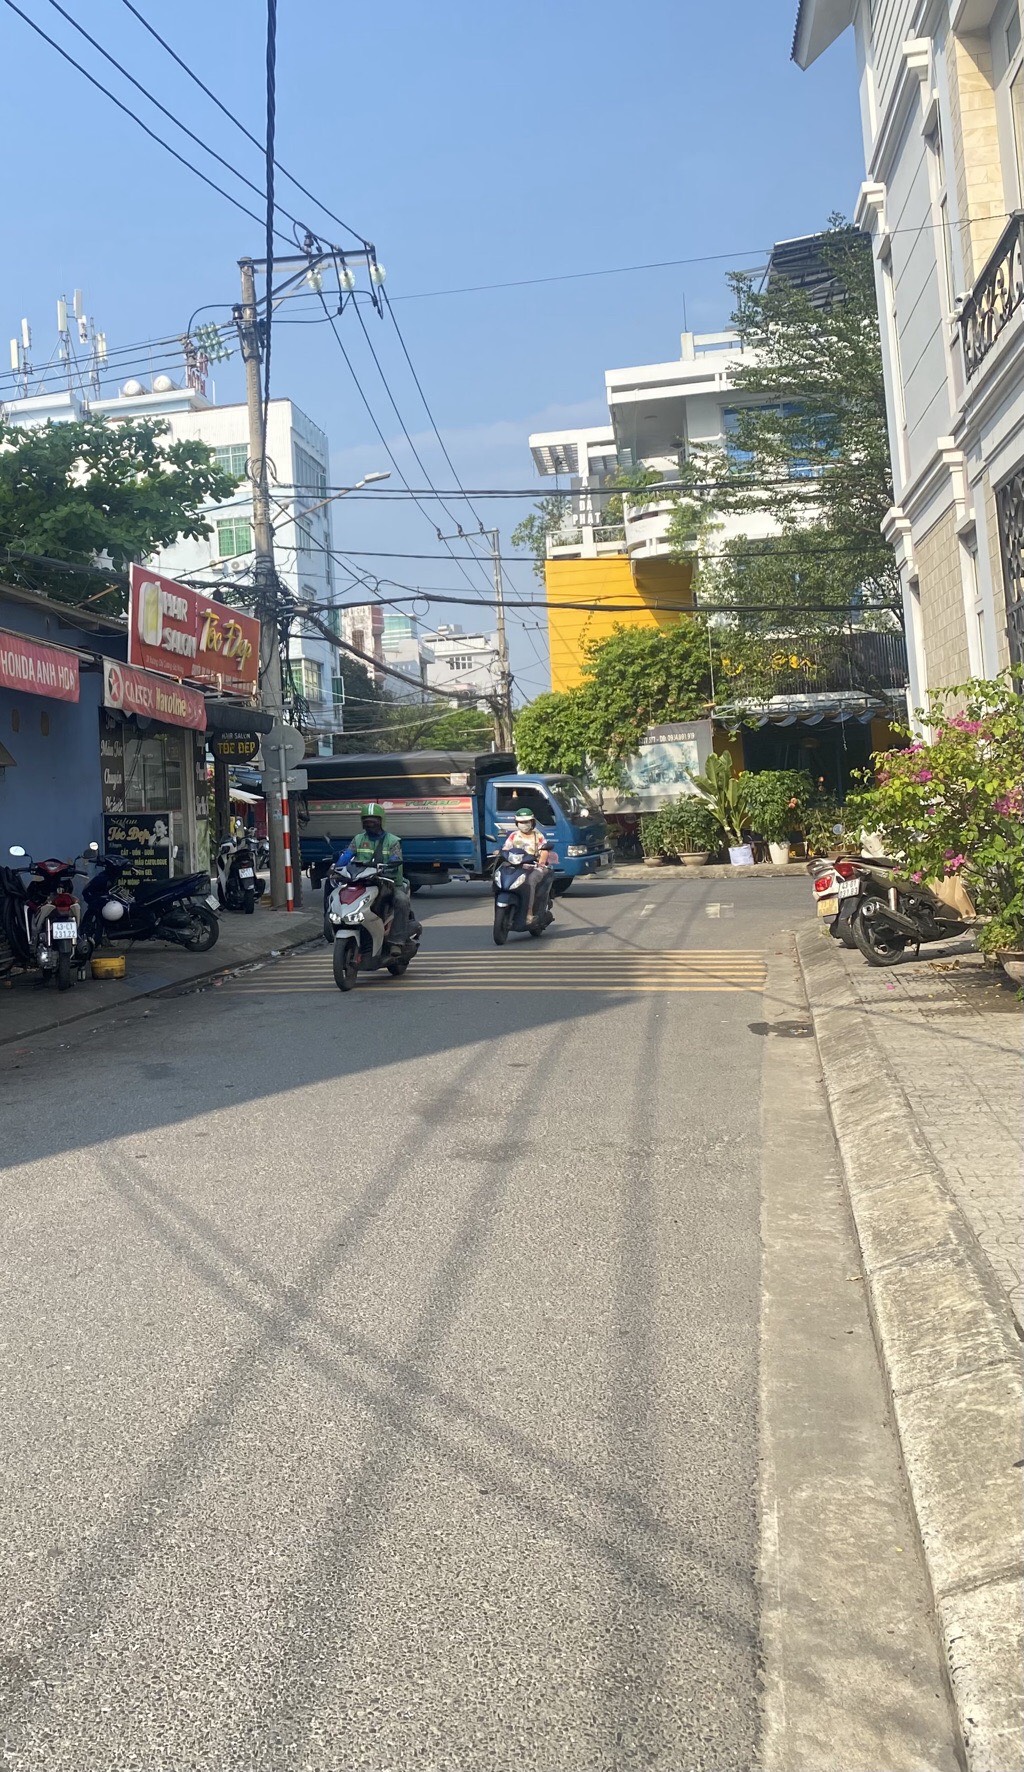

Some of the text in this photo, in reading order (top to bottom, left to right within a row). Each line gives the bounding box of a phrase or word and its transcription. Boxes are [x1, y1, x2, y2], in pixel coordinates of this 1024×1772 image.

[160, 591, 188, 622] HAIR
[162, 627, 198, 659] SALON
[0, 650, 36, 681] HONDA
[36, 660, 56, 686] ANH
